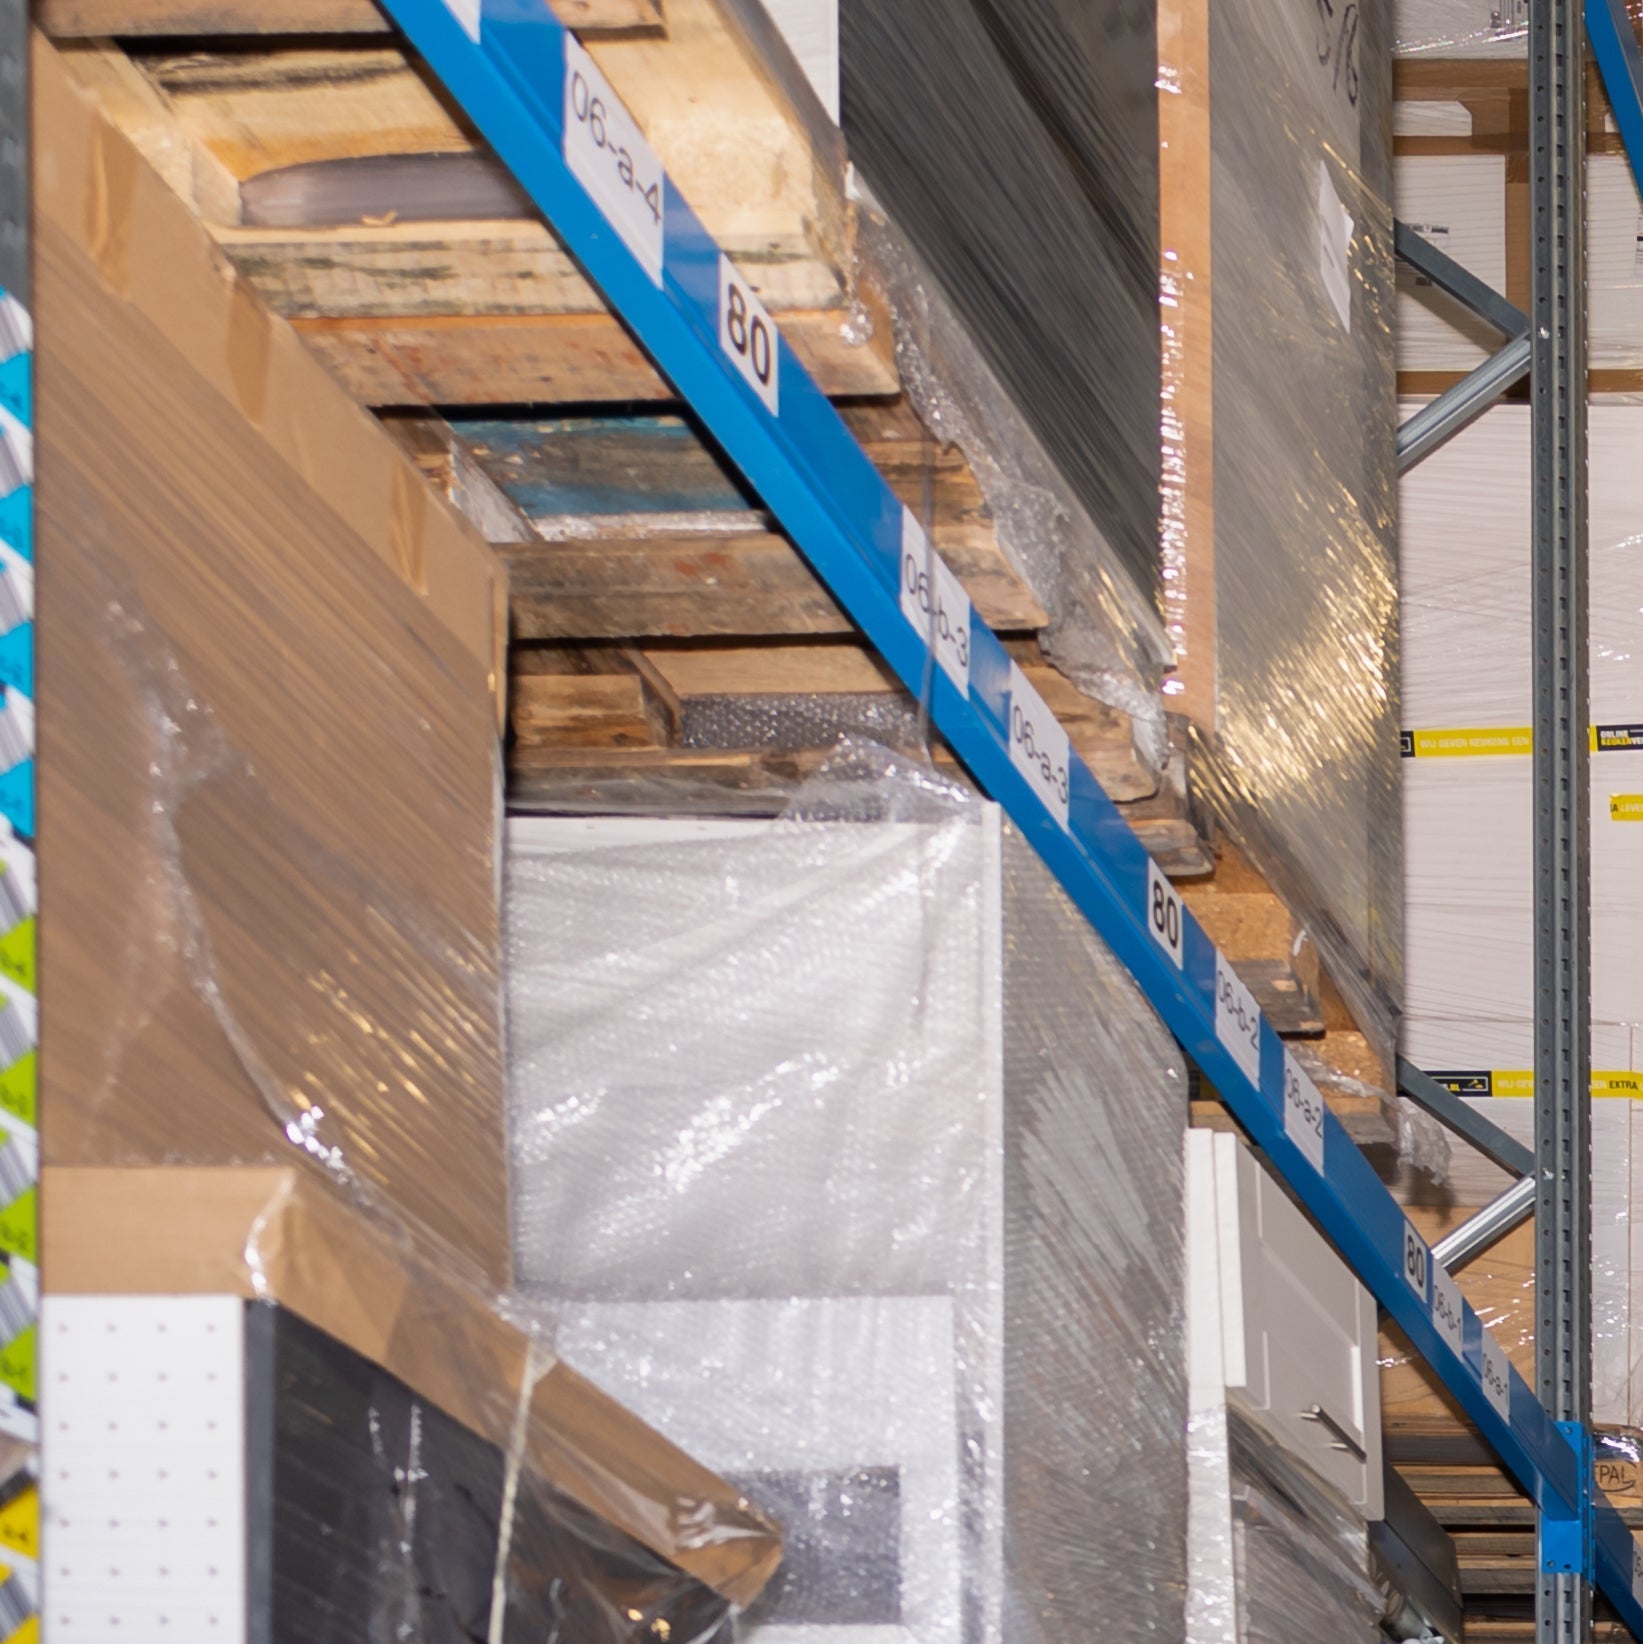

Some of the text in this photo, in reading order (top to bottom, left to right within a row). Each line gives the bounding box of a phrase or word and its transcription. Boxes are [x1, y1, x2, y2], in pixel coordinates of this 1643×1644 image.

[572, 70, 662, 226] 06-a-4
[727, 283, 770, 387] 80
[905, 553, 968, 667] 06-b-3
[1013, 705, 1068, 805] 06-a-3
[1420, 739, 1436, 749] WIJ
[1153, 880, 1178, 949] 80
[1218, 970, 1259, 1052] 06-b-2
[1286, 1067, 1323, 1139] 06-a-2
[1609, 1080, 1638, 1090] EXTRA
[1407, 1234, 1425, 1288] 80
[1434, 1284, 1461, 1342] 06-b-1
[1483, 1353, 1508, 1409] 06-a-1
